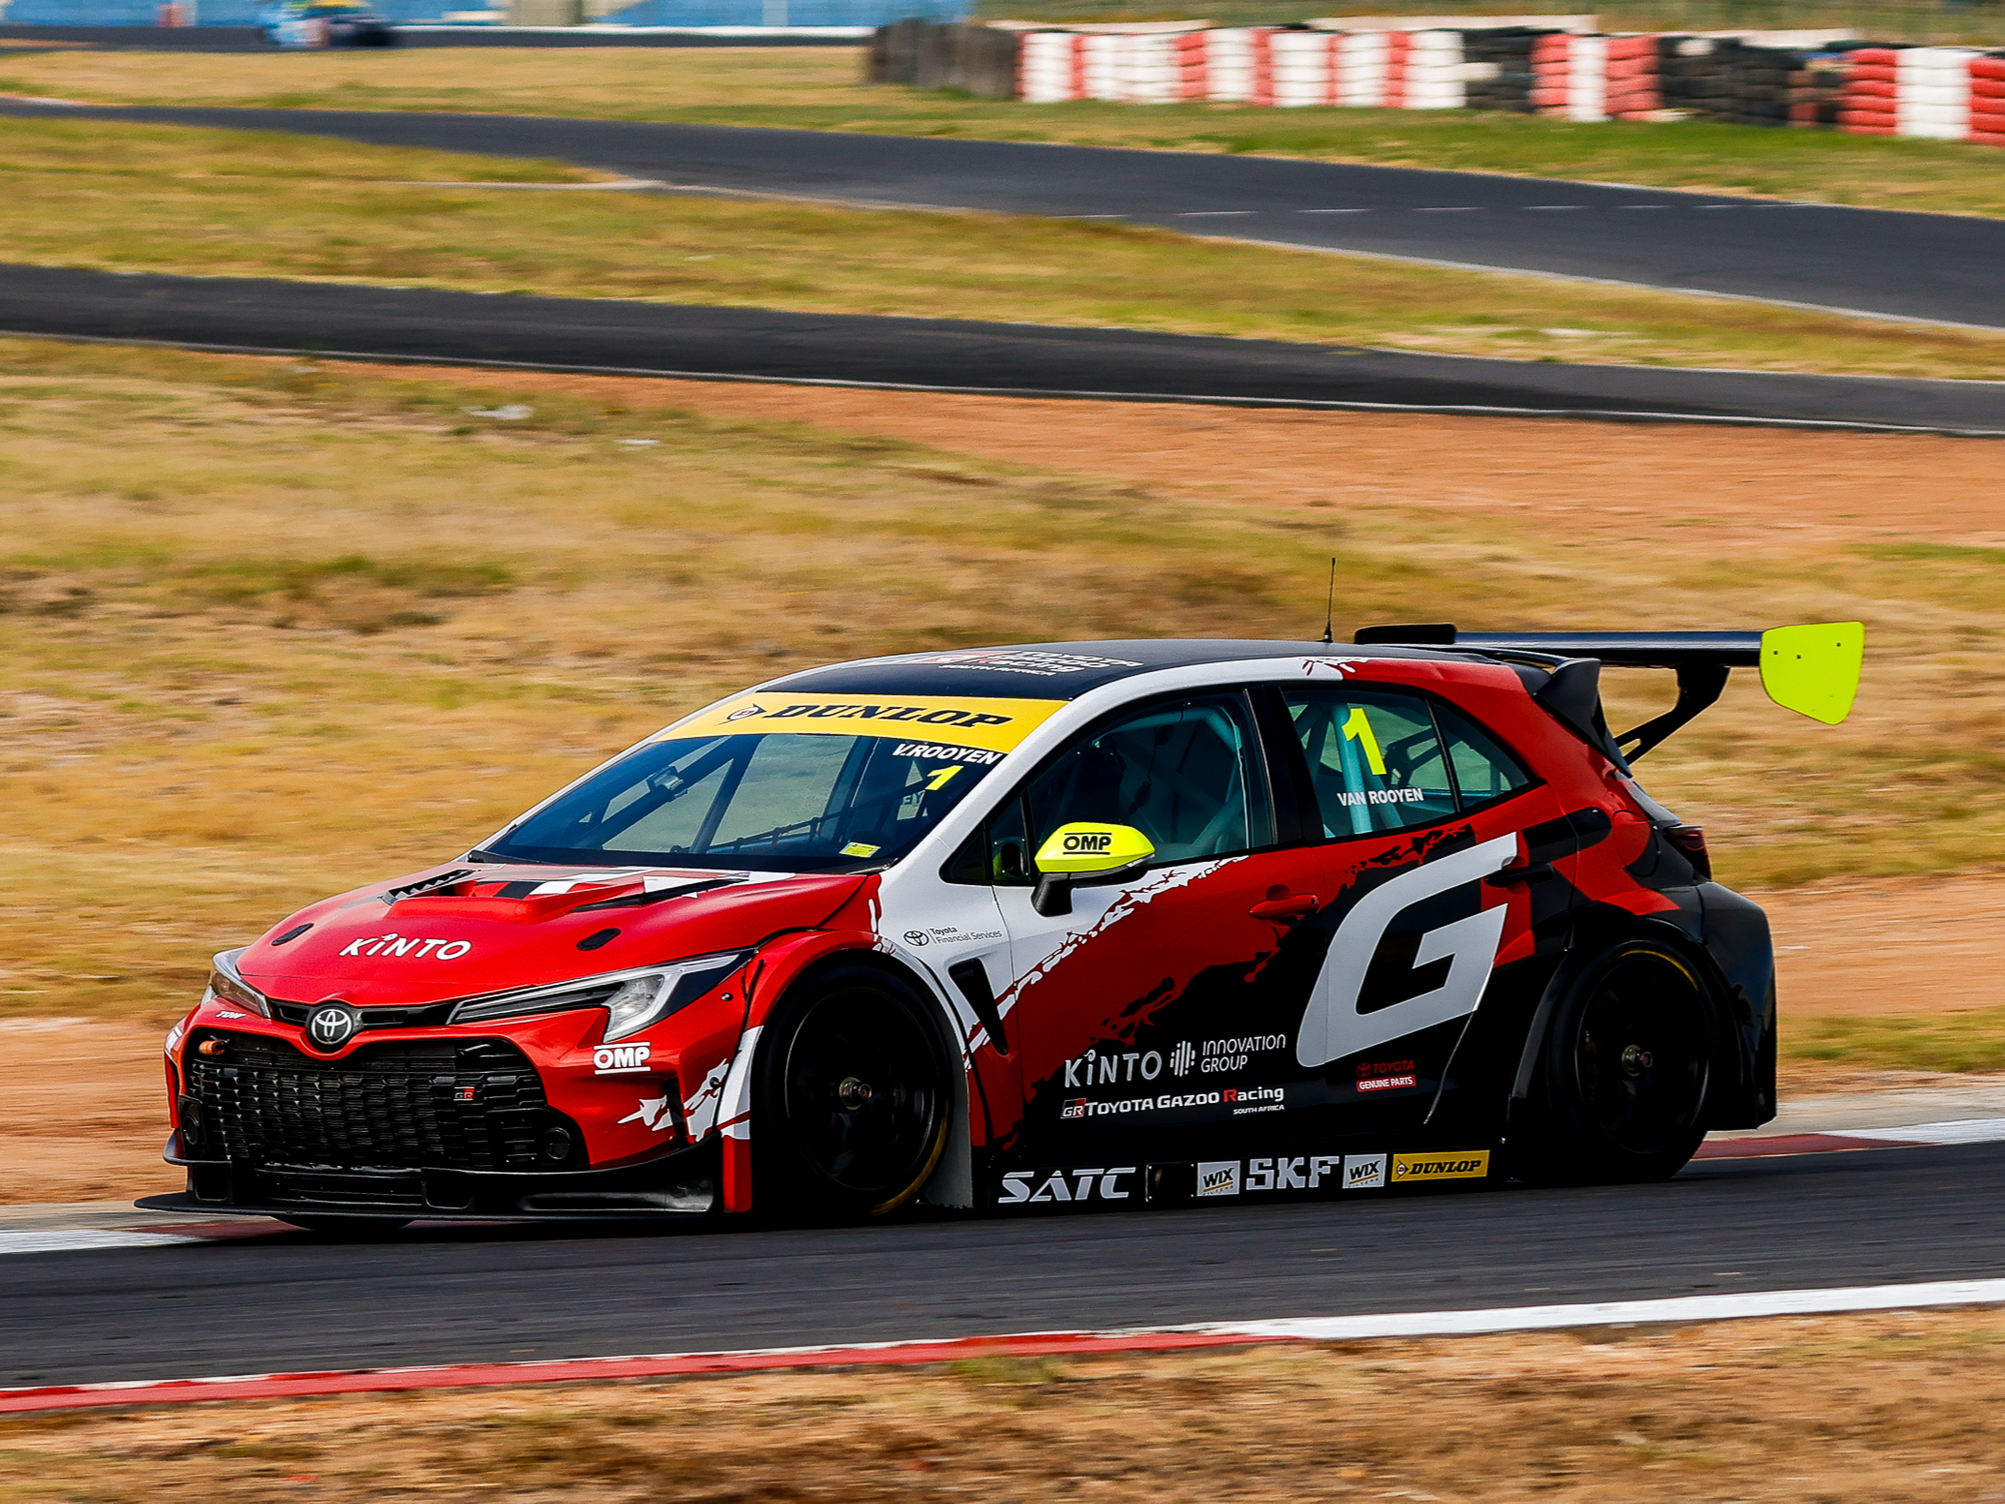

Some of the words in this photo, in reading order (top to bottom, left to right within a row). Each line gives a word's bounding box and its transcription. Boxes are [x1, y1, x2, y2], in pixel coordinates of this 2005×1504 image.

[763, 704, 1015, 728] DUNLOP
[1341, 707, 1387, 775] 1
[892, 743, 1003, 765] V.ROOYEN
[925, 765, 964, 791] 1
[1337, 791, 1366, 807] VAN
[1369, 788, 1425, 805] ROOYEN
[1063, 835, 1111, 851] OMP
[929, 926, 957, 936] Toyota
[936, 933, 972, 944] Financial
[972, 930, 1002, 940] Services
[1296, 831, 1518, 1068] G
[593, 1047, 651, 1069] OMP
[1200, 1055, 1248, 1073] GROUP
[1372, 1060, 1415, 1074] TOYOTA
[1359, 1079, 1390, 1090] GENUINE
[1390, 1076, 1413, 1087] PARTS
[1085, 1098, 1154, 1117] TOYOTA
[1157, 1092, 1220, 1109] GAZOO
[1223, 1086, 1285, 1102] Racing
[1233, 1107, 1257, 1115] SOUTH
[1258, 1104, 1285, 1113] AFRICA
[1203, 1167, 1235, 1188] WIX
[1246, 1155, 1340, 1191] SKF
[1349, 1160, 1381, 1181] WIX
[1409, 1160, 1482, 1175] DUNLOP
[998, 1167, 1136, 1203] SATC
